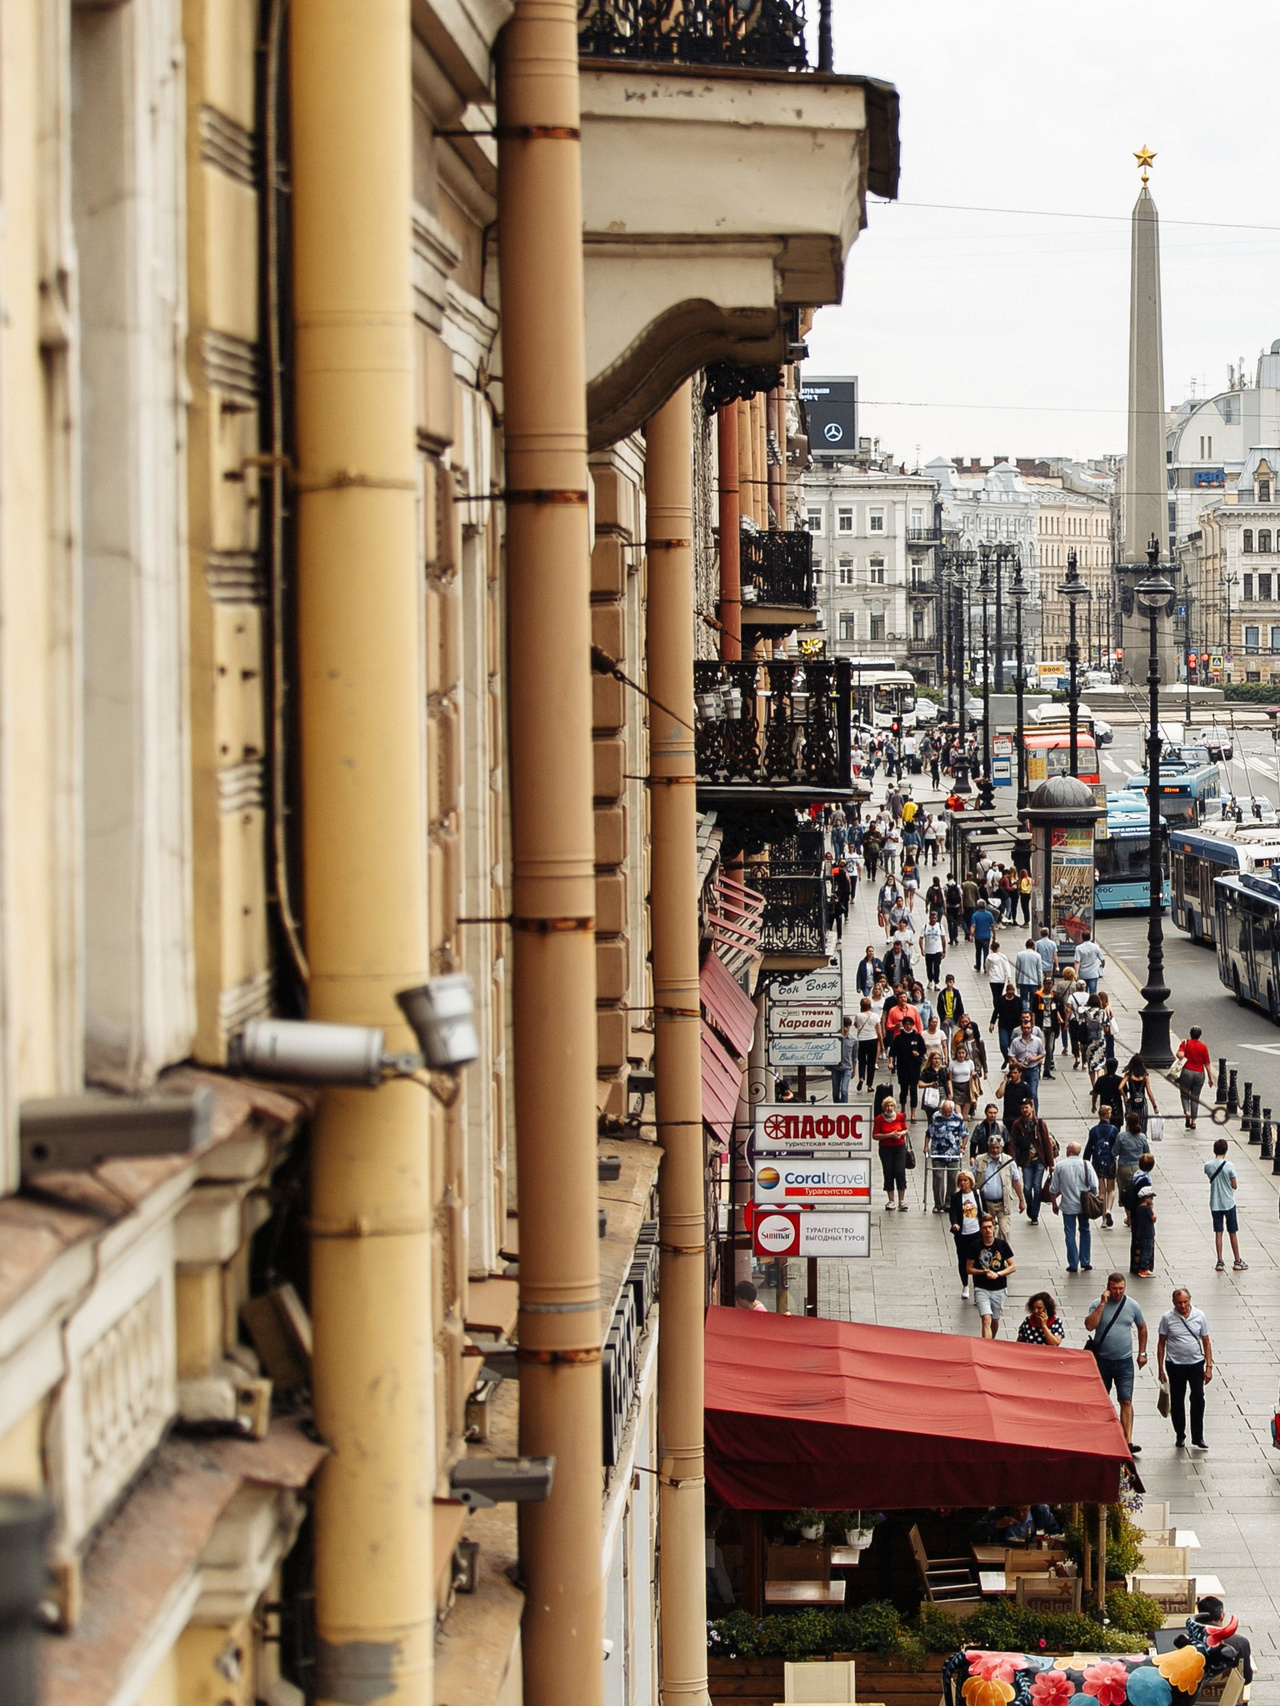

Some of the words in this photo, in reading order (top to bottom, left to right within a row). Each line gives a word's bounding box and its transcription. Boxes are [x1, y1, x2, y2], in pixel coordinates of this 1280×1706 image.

[805, 979, 839, 992] Вояж
[778, 1018, 832, 1030] Караван
[785, 1114, 863, 1140] ПАФОС
[804, 1188, 853, 1196] Турагентство
[761, 1231, 791, 1240] Sunmar
